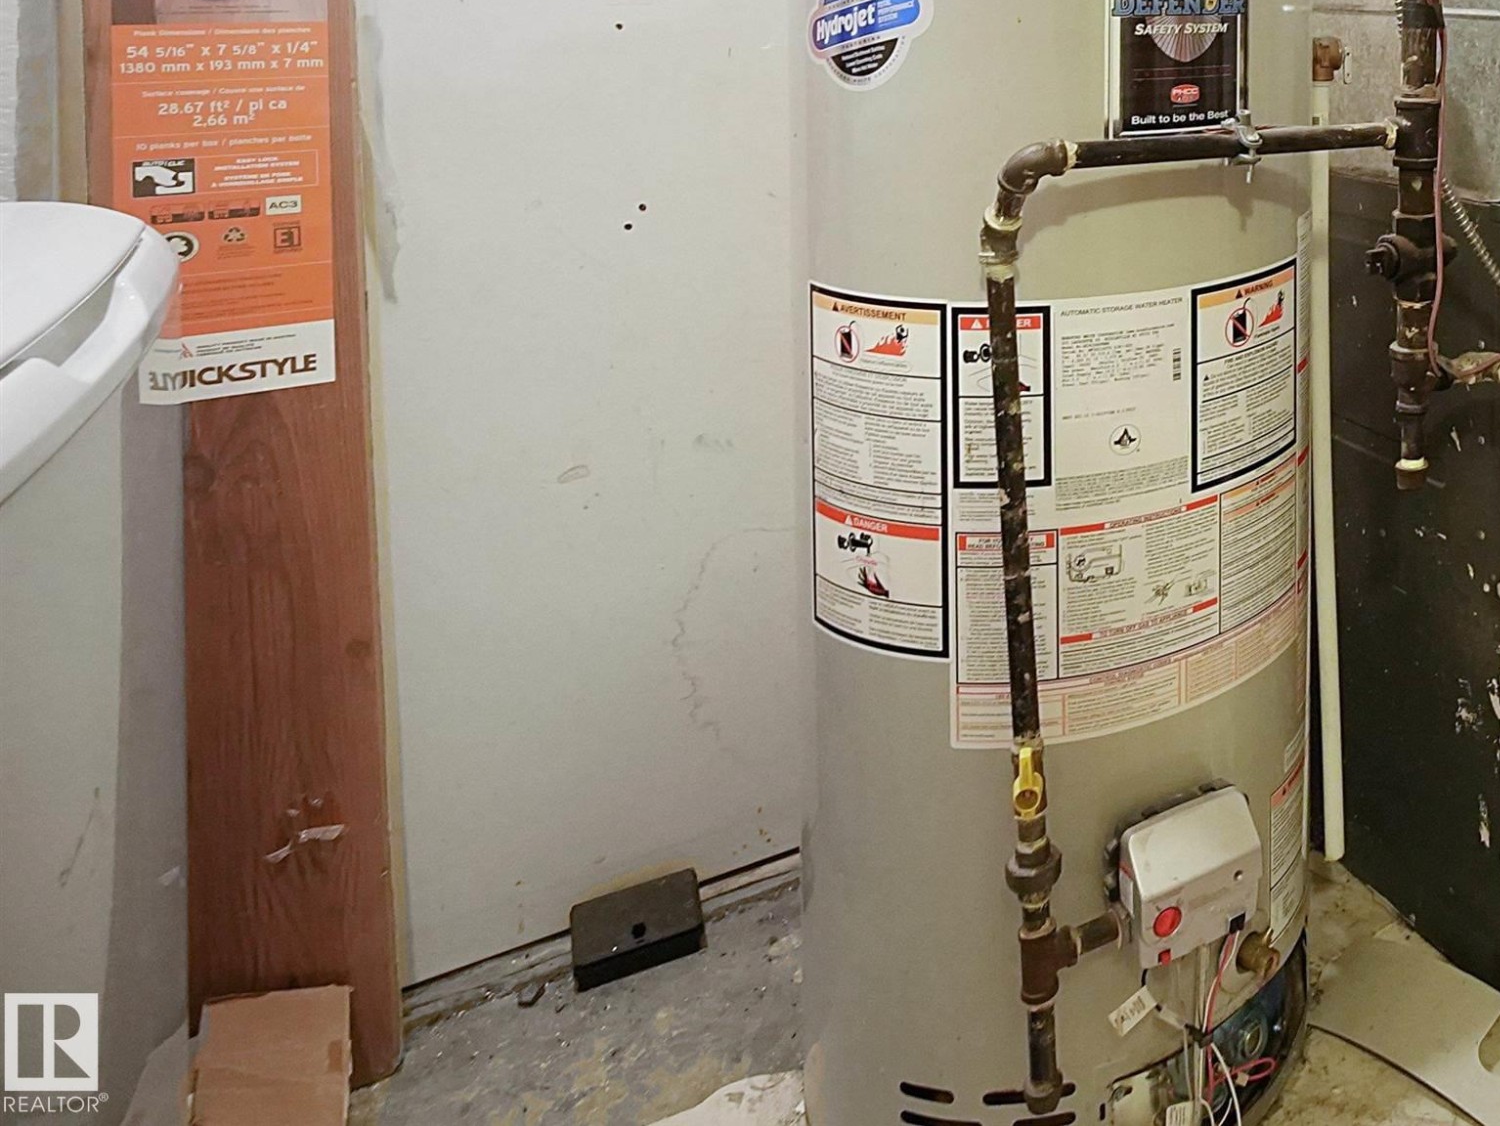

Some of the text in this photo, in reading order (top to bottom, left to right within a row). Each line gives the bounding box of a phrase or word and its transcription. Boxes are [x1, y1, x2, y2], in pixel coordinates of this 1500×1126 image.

[816, 3, 876, 44] Hydrojet
[1134, 22, 1228, 36] SAFETY SYSTEM
[126, 46, 149, 59] 54
[217, 44, 227, 55] 7
[120, 57, 324, 74] 1380 mm x 193 mm x 7 mm
[158, 101, 204, 116] 28.67
[268, 99, 288, 110] ca
[1131, 110, 1229, 125] Built to be the Best
[268, 199, 299, 210] AC3
[840, 304, 907, 321] AVERTISSEMENT
[1060, 297, 1183, 317] AUTOMATIC STORAGE WATER HEATER
[852, 517, 888, 534] DANGER
